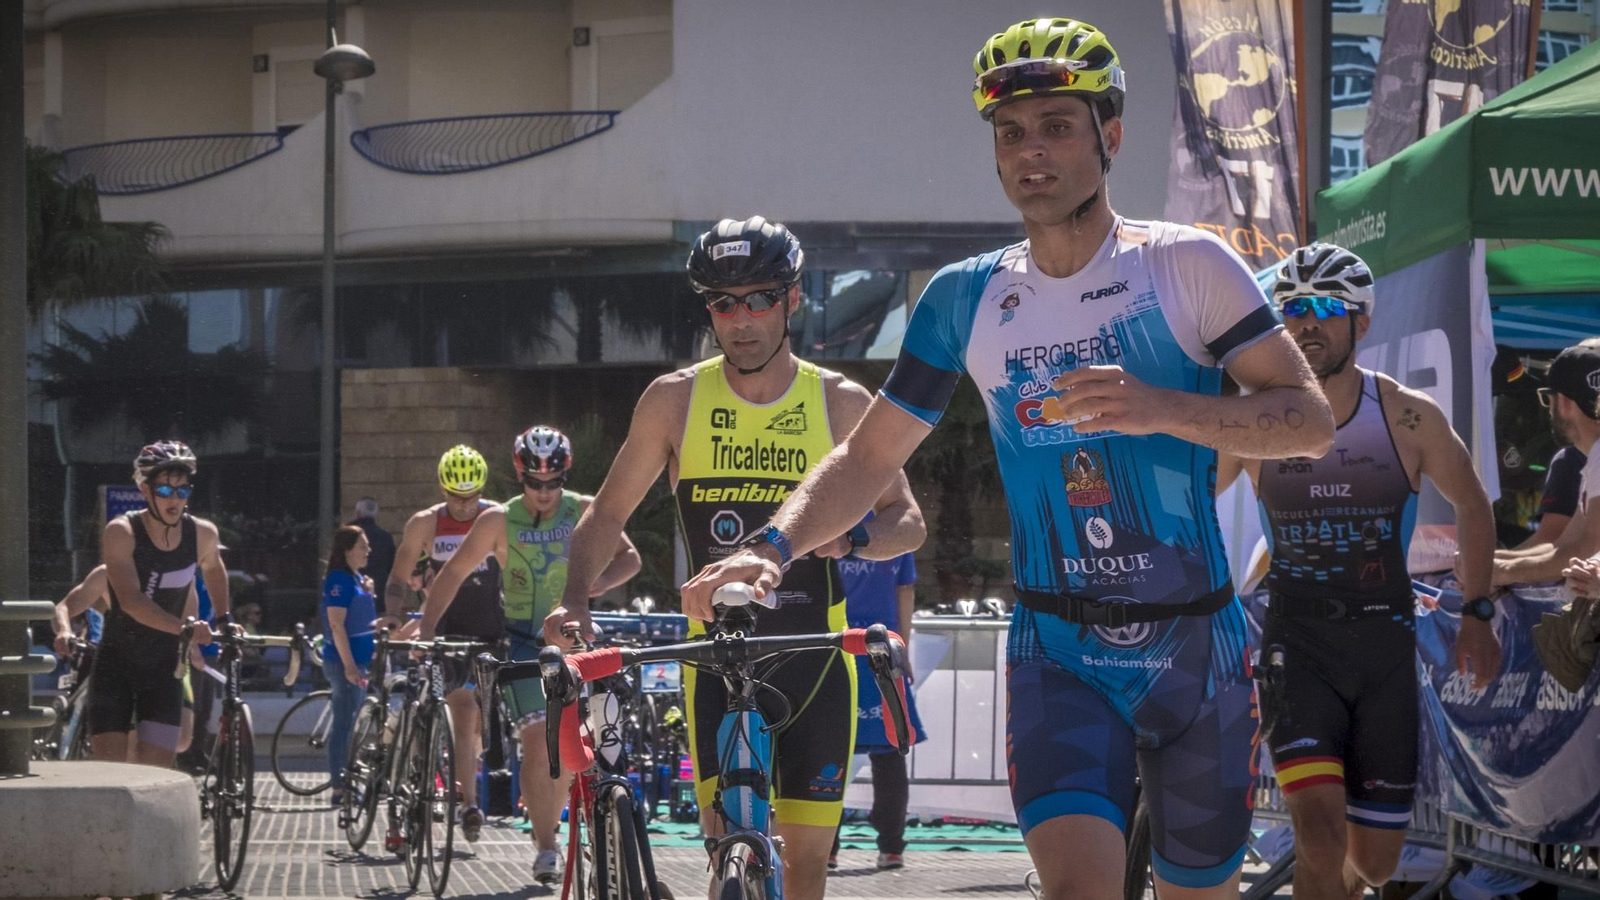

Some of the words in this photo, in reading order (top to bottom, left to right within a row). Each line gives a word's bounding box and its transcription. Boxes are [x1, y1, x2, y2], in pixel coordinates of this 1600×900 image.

[726, 245, 742, 253] 347
[1081, 280, 1129, 302] FURIOX
[1020, 381, 1048, 397] Club
[711, 435, 807, 474] Tricaletero
[691, 483, 793, 503] benibik
[1310, 484, 1352, 498] RUIZ
[517, 525, 571, 542] GARRIDO
[1062, 553, 1154, 575] DUQUE
[1092, 575, 1147, 586] ACACIAS
[656, 666, 665, 679] 2
